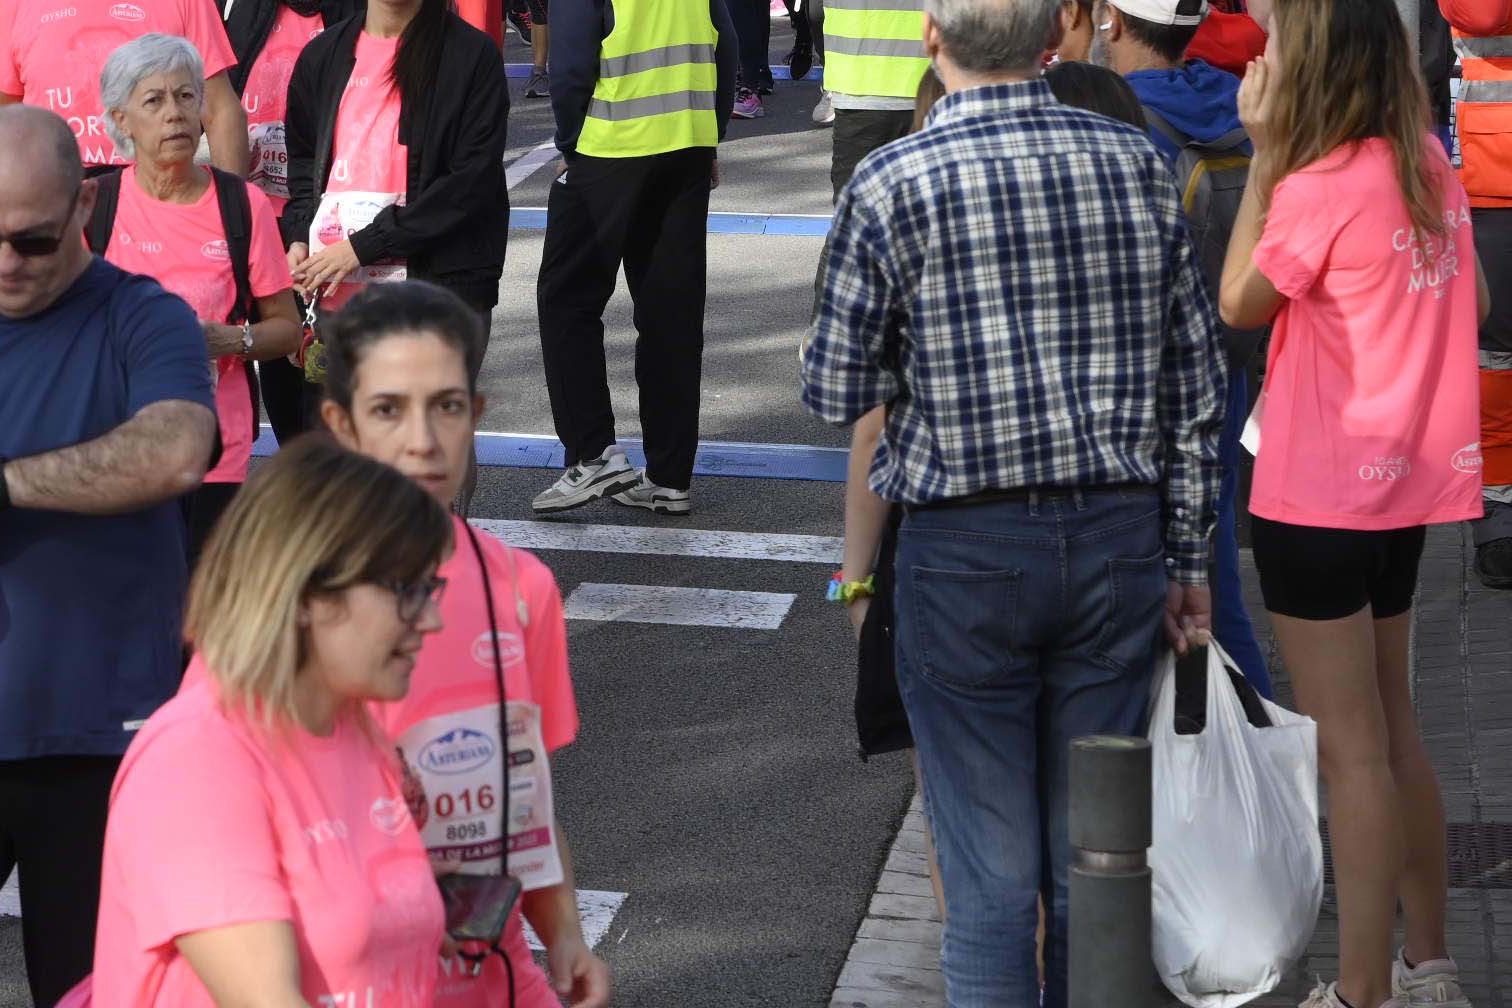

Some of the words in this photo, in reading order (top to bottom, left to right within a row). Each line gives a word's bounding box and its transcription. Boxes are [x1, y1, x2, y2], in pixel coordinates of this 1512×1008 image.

[40, 7, 77, 23] OYSHO
[45, 87, 73, 110] TU
[263, 150, 287, 164] 016
[435, 784, 495, 818] 016
[446, 821, 487, 841] 8098
